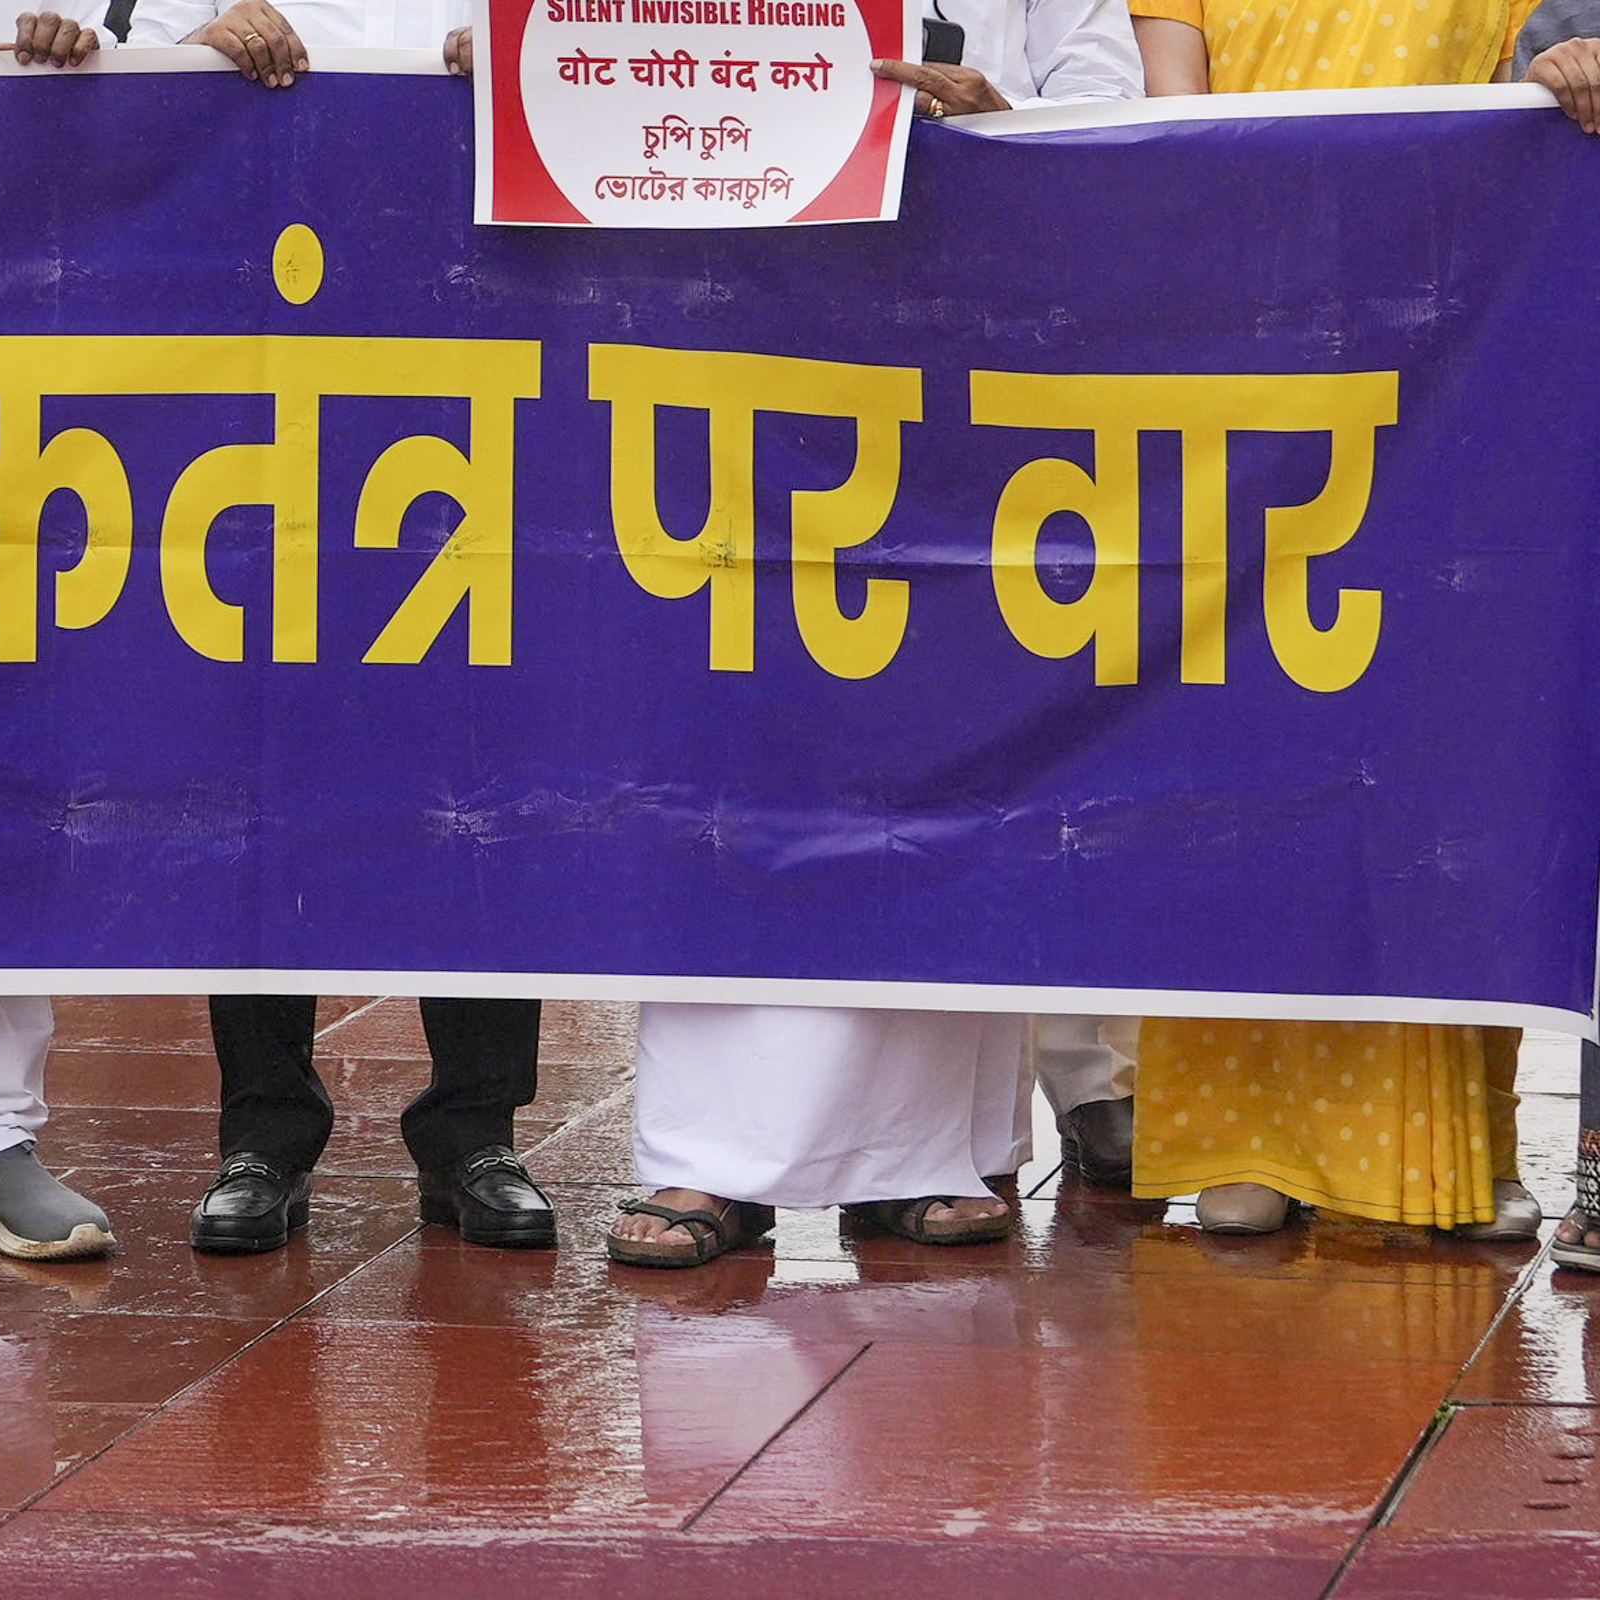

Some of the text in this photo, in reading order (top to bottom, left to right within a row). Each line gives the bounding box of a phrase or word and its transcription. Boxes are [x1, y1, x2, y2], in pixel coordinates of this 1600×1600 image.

[557, 48, 833, 93] वोट चोरी बंद करो
[642, 114, 752, 161] চুপি চুপি
[595, 166, 795, 210] ভোটের কারচুপি
[587, 342, 924, 681] पर
[969, 369, 1399, 694] वार
